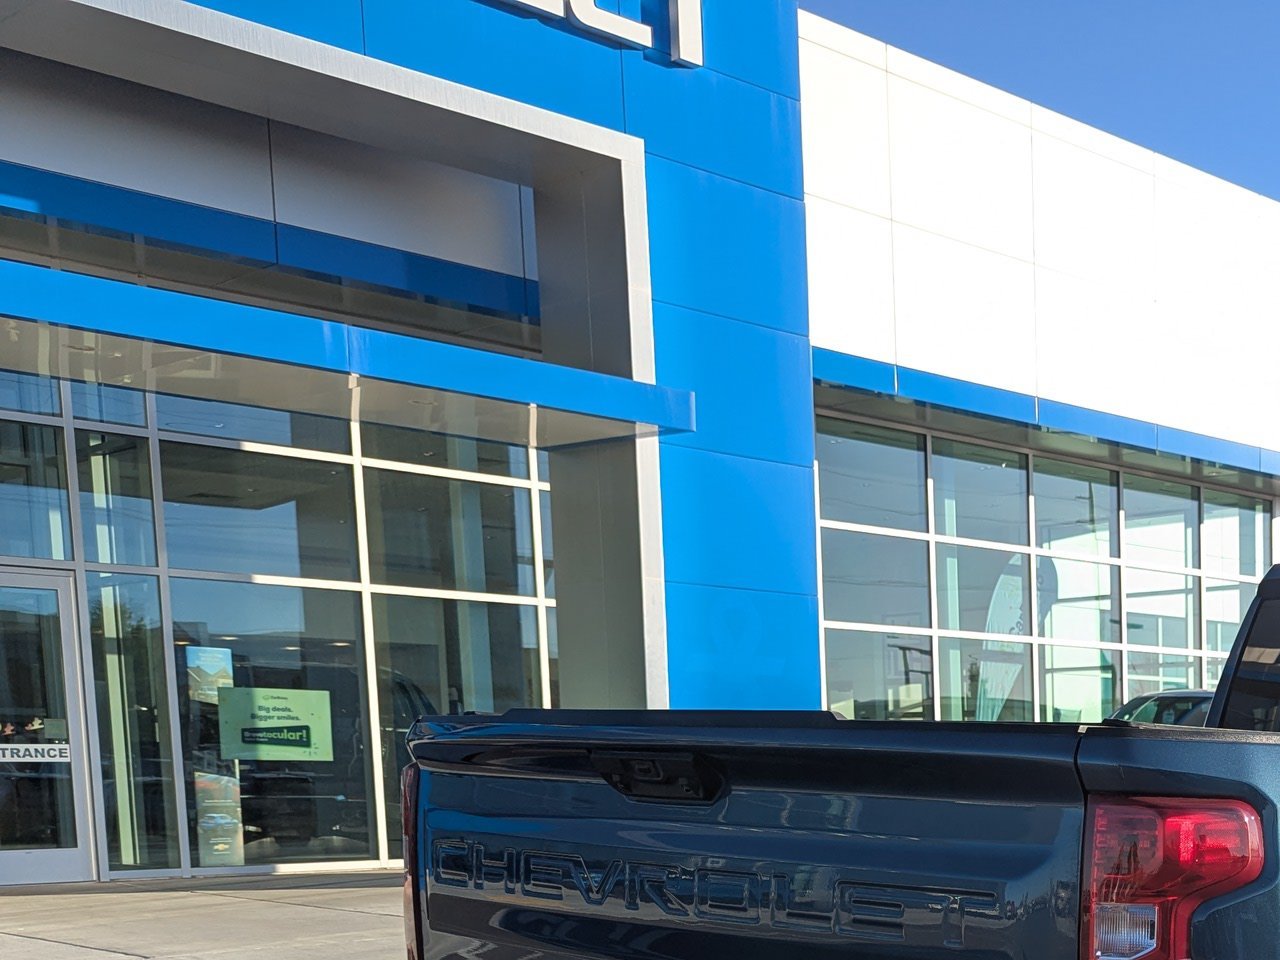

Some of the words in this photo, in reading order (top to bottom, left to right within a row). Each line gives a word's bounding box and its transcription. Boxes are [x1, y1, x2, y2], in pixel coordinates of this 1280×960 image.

[257, 705, 270, 713] Big
[271, 705, 294, 713] deals.
[250, 712, 275, 721] Bigger
[276, 713, 302, 721] smiles.
[0, 748, 68, 758] TRANCE
[432, 838, 1003, 949] CHEVROLET
